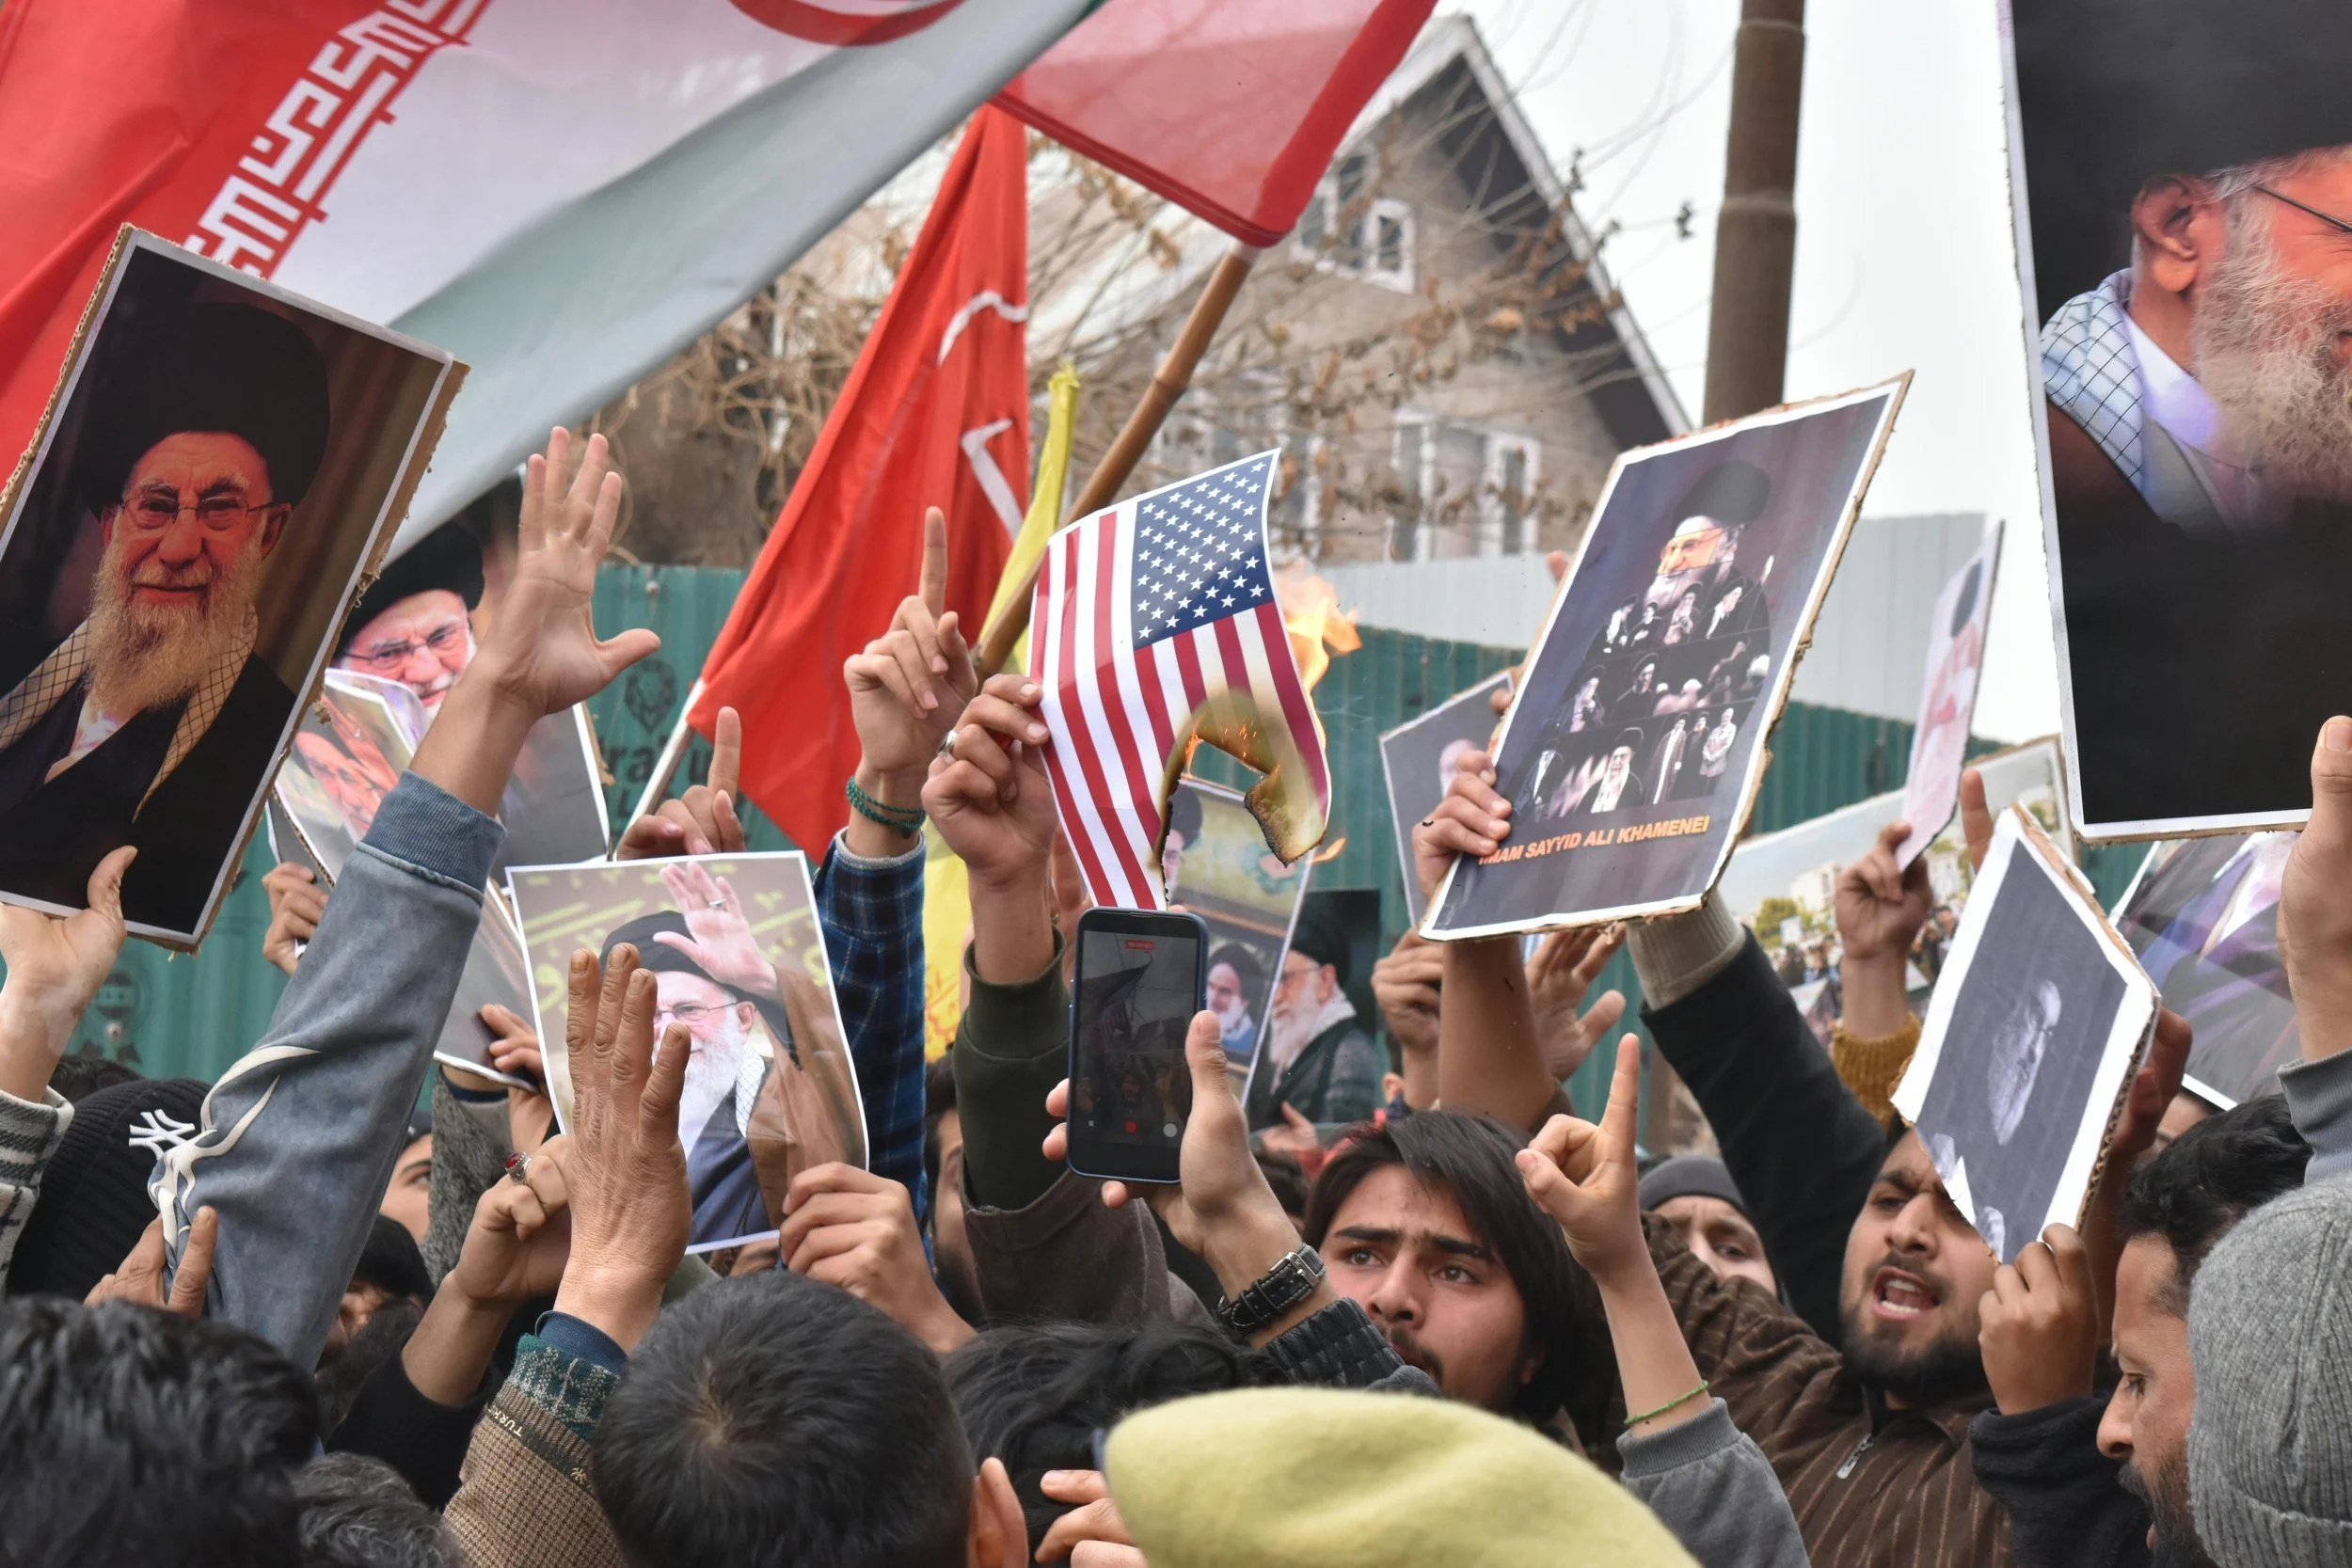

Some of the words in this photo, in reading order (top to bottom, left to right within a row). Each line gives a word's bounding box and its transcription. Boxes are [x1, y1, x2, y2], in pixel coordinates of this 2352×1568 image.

[1525, 832, 1582, 860] SAYYID
[1583, 829, 1615, 847] ALI
[1616, 816, 1711, 844] KHAMENEI
